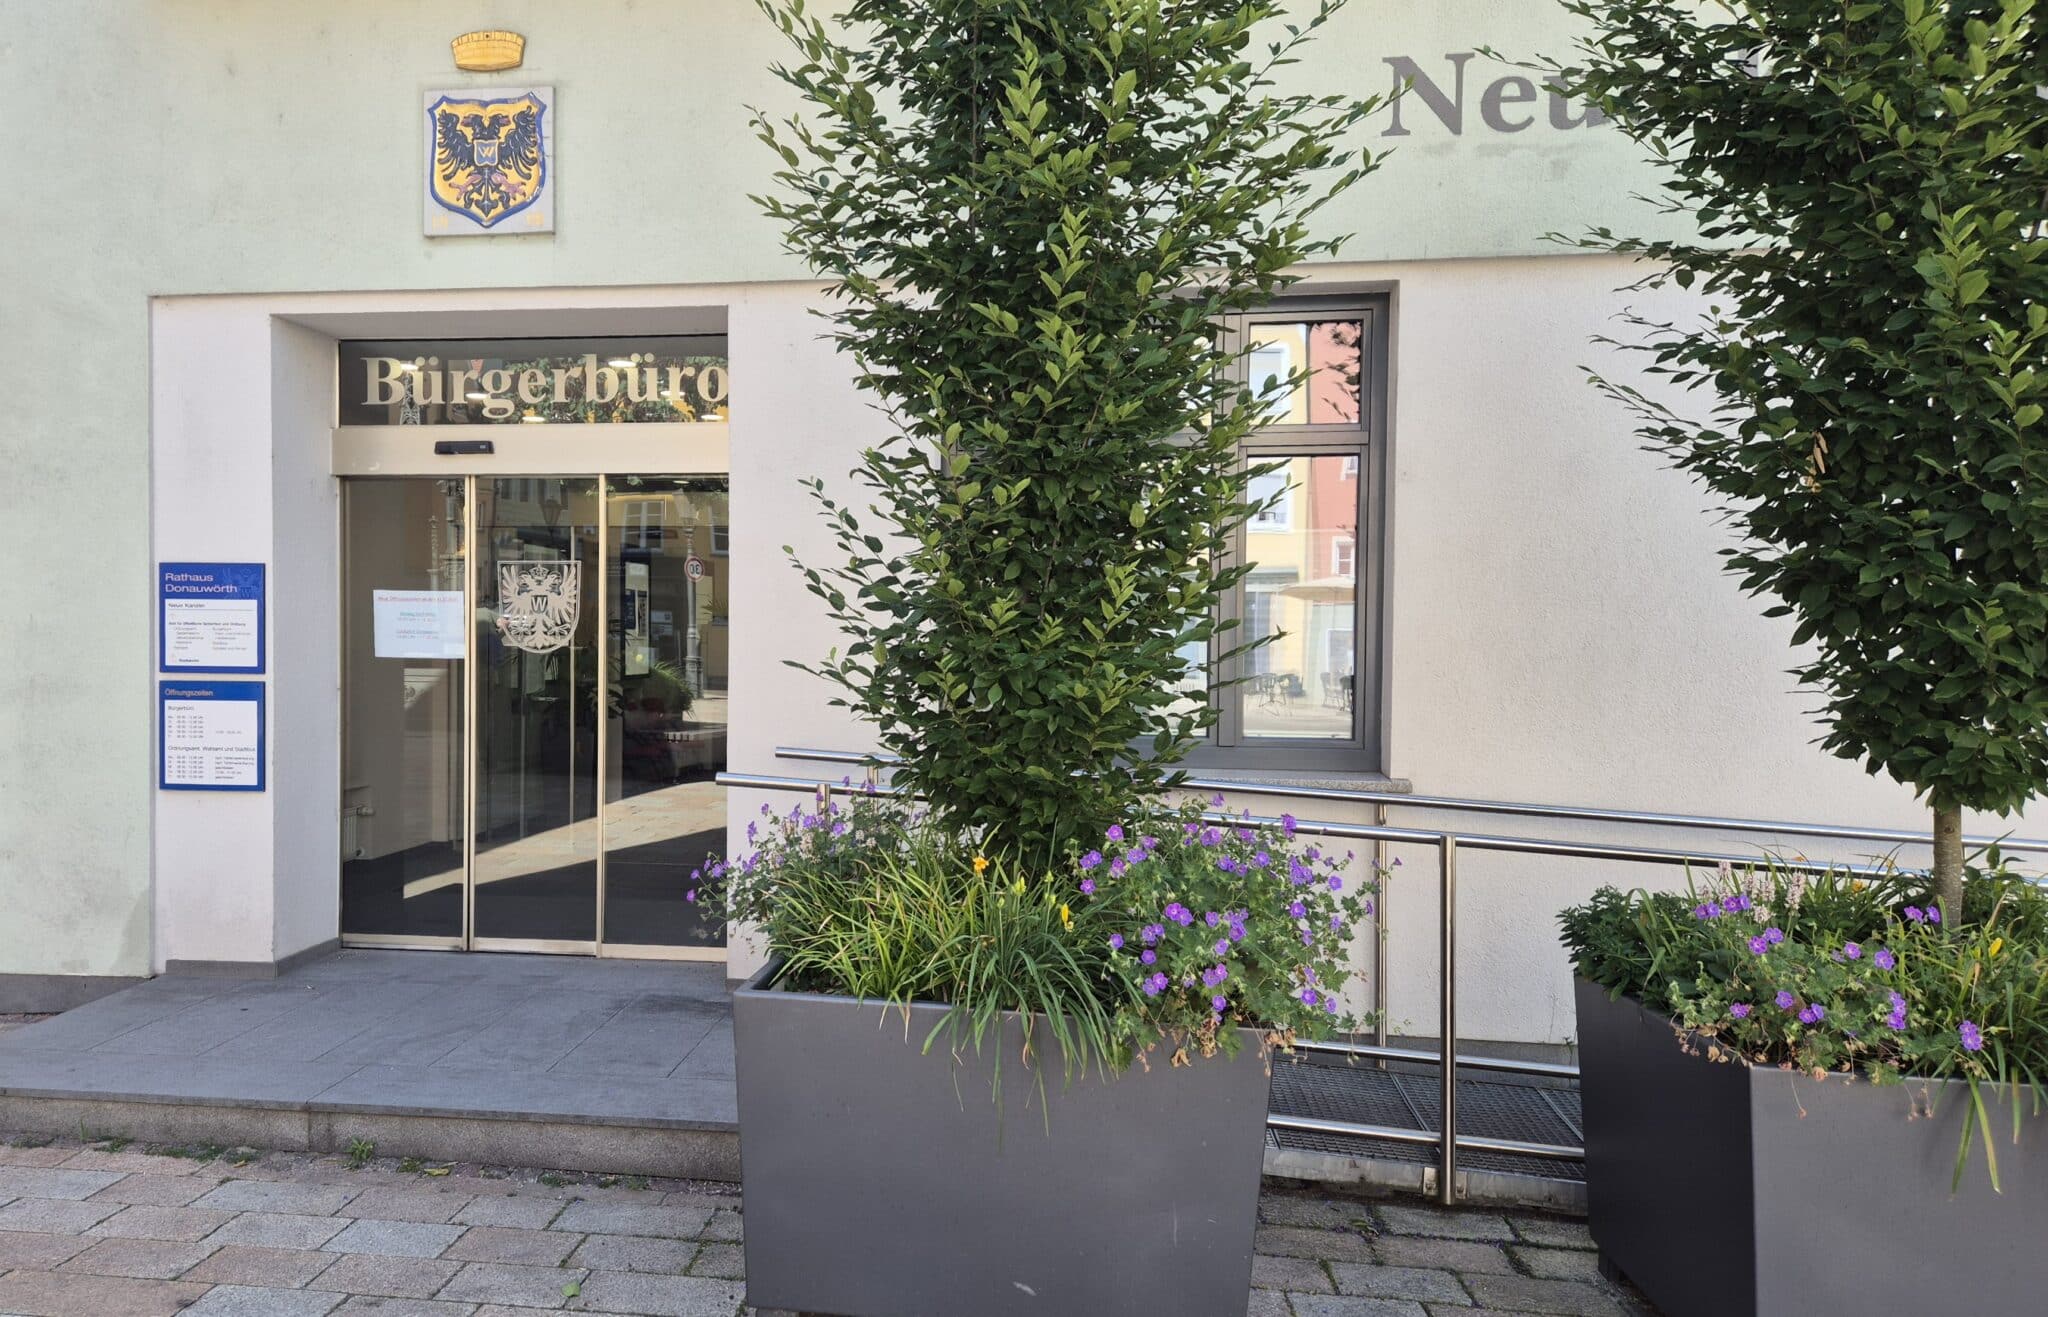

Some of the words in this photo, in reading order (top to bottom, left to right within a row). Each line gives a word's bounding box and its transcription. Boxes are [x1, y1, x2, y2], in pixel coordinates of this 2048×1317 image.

[360, 352, 729, 419] Bürgerbüro
[165, 572, 214, 582] Rathaus
[165, 583, 238, 593] Donauwörth
[532, 596, 547, 612] W
